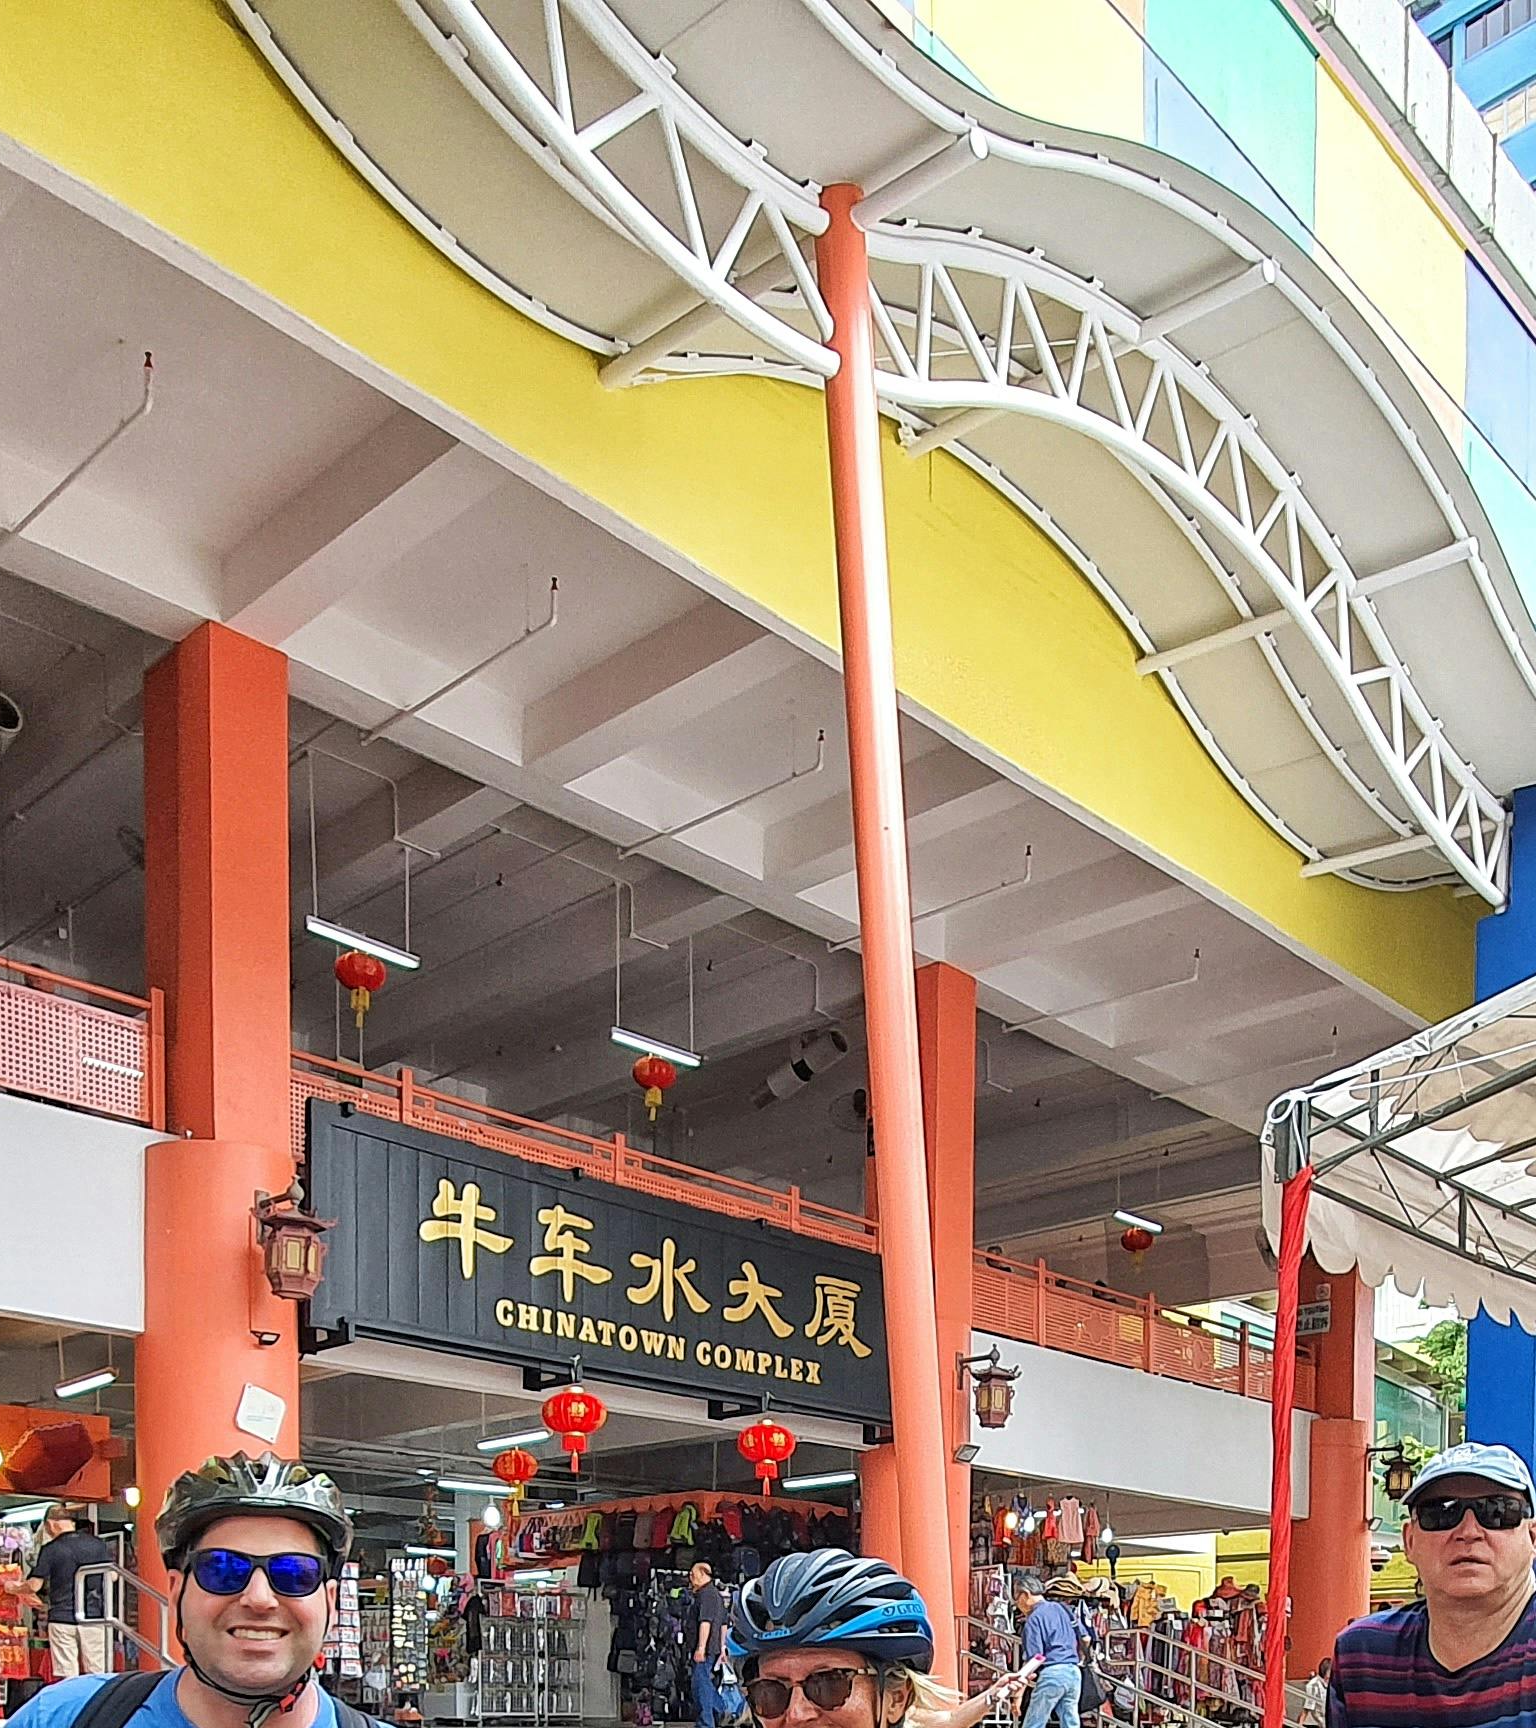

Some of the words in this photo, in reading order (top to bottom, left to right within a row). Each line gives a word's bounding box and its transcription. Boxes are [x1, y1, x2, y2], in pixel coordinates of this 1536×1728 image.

[419, 1177, 873, 1358] 牛车水大厦
[495, 1298, 686, 1361] CHINATOWN
[696, 1340, 823, 1385] COMPLEX
